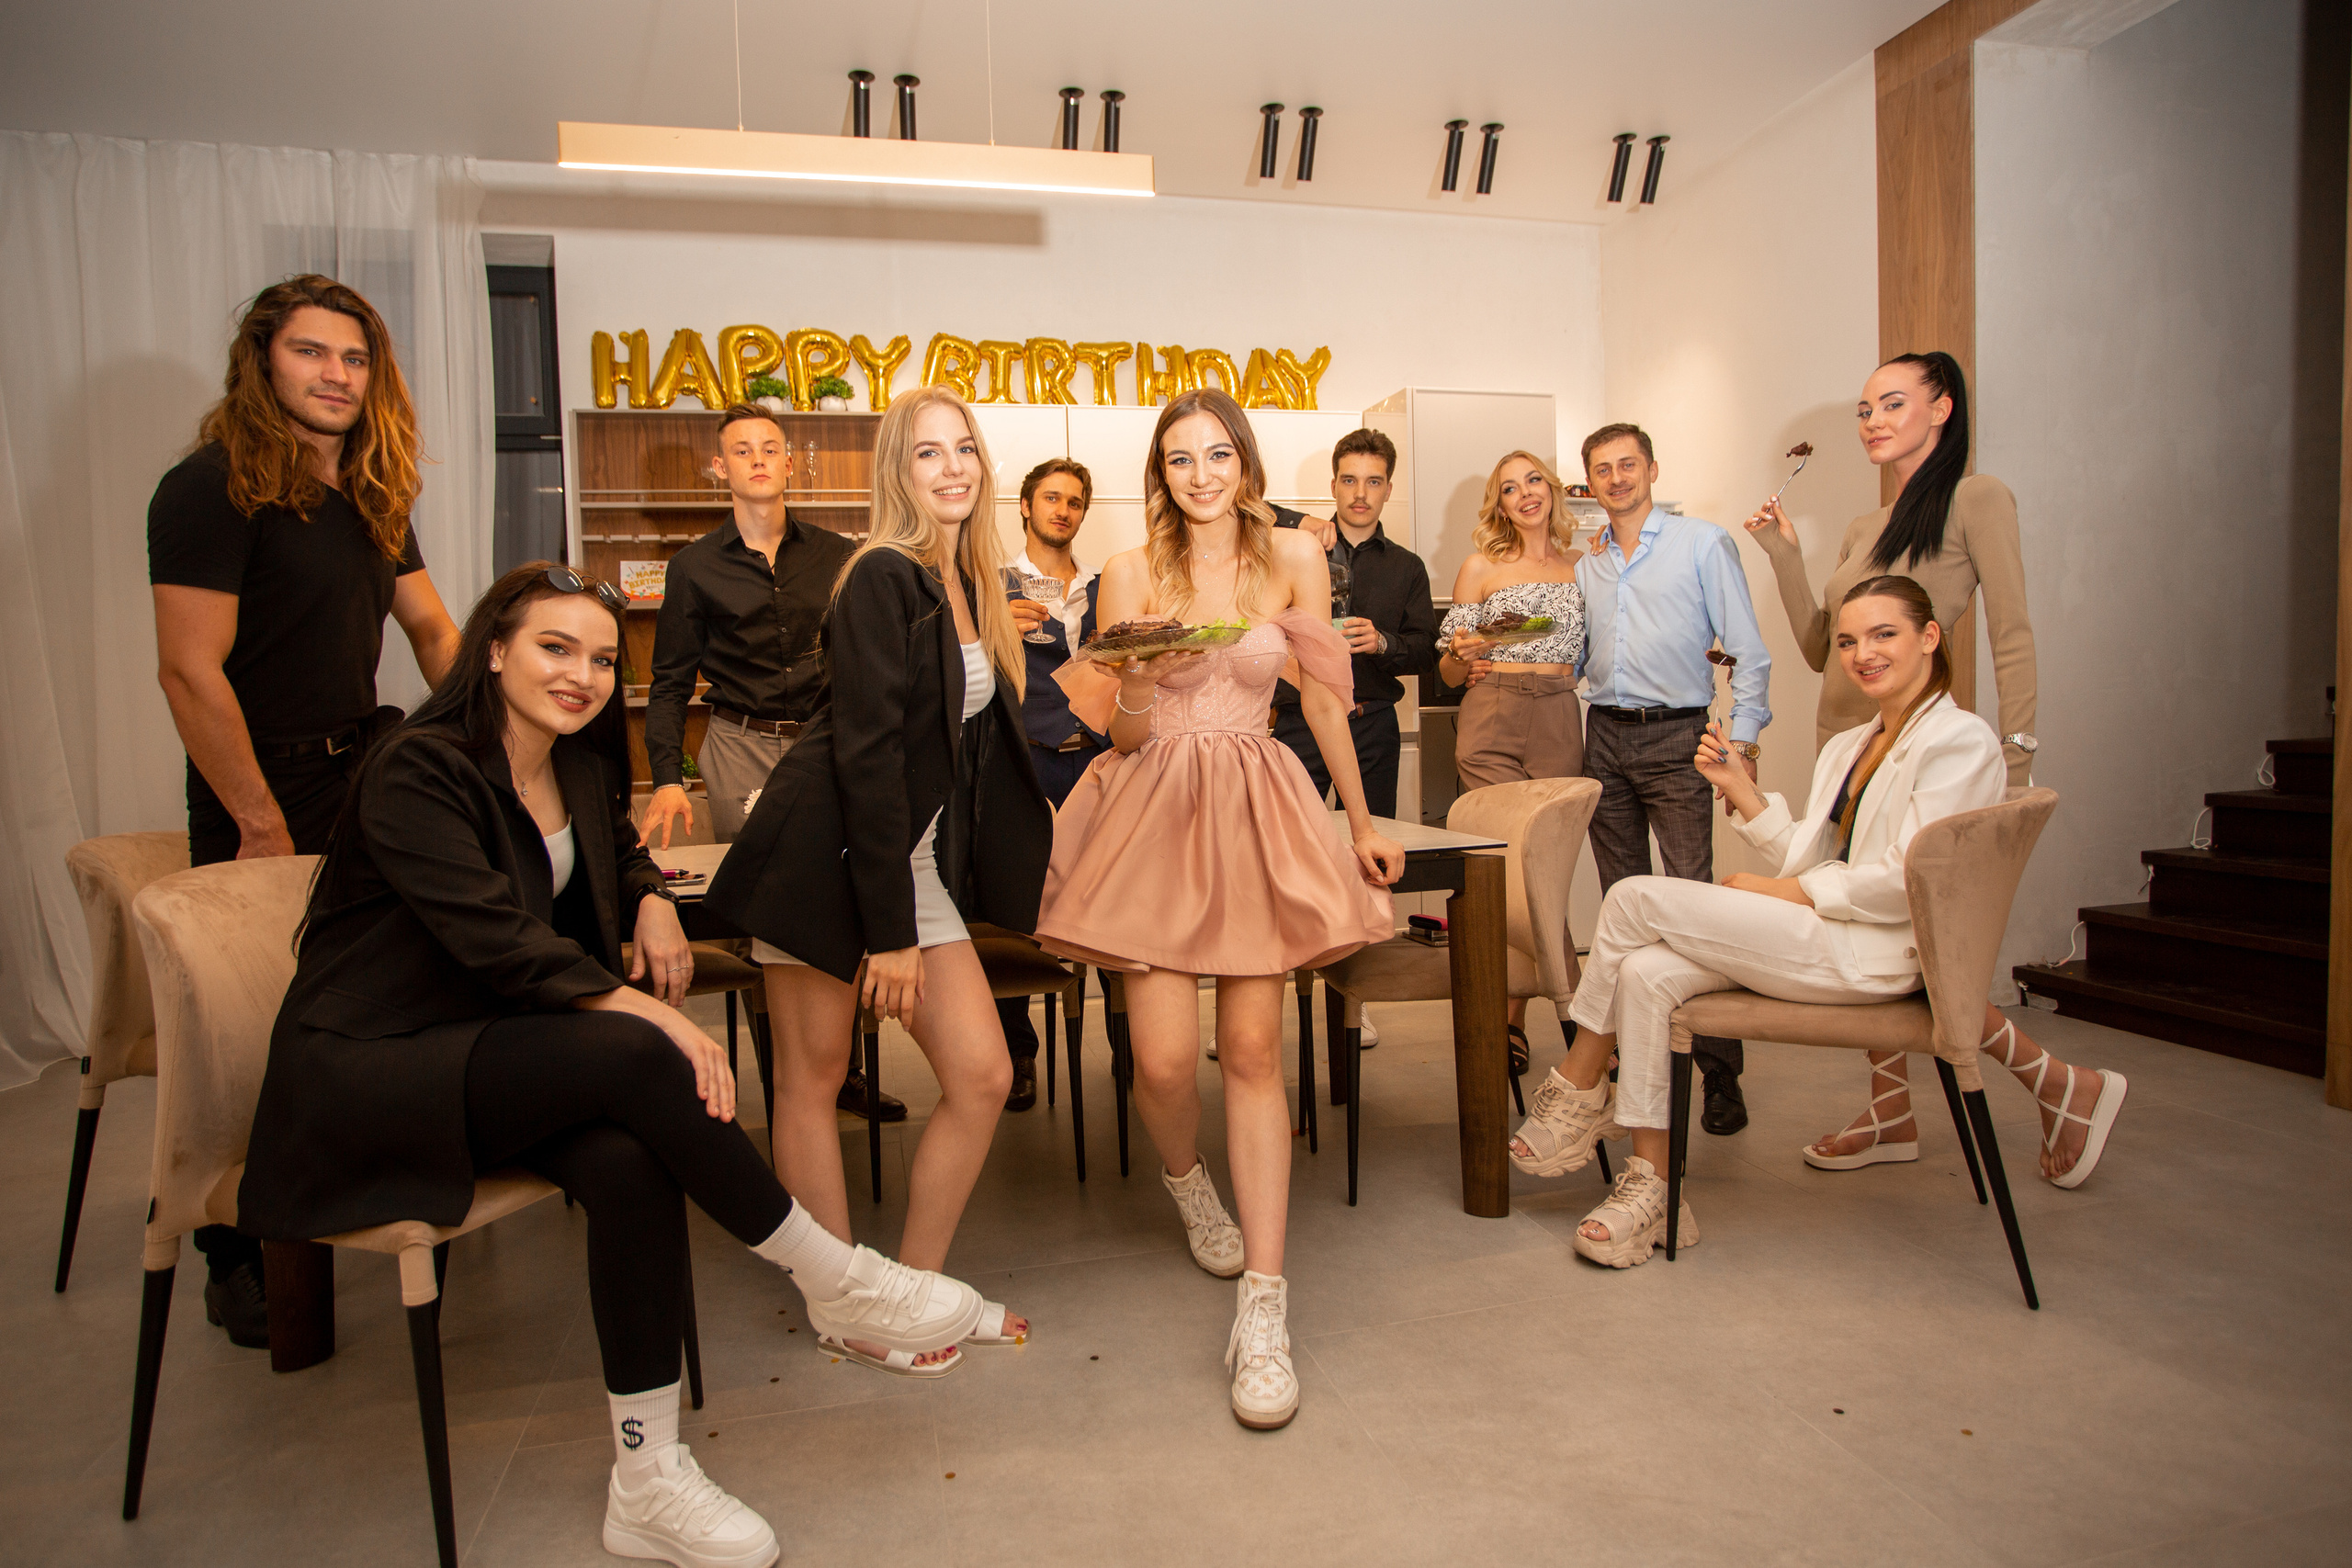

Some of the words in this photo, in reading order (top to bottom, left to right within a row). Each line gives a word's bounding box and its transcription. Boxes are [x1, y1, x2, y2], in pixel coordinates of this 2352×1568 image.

[592, 324, 912, 412] HAPPY
[921, 333, 1332, 411] BIRTHDAY
[628, 577, 665, 589] BIRTHDA
[636, 570, 665, 580] HAPPY
[621, 1416, 645, 1451] $
